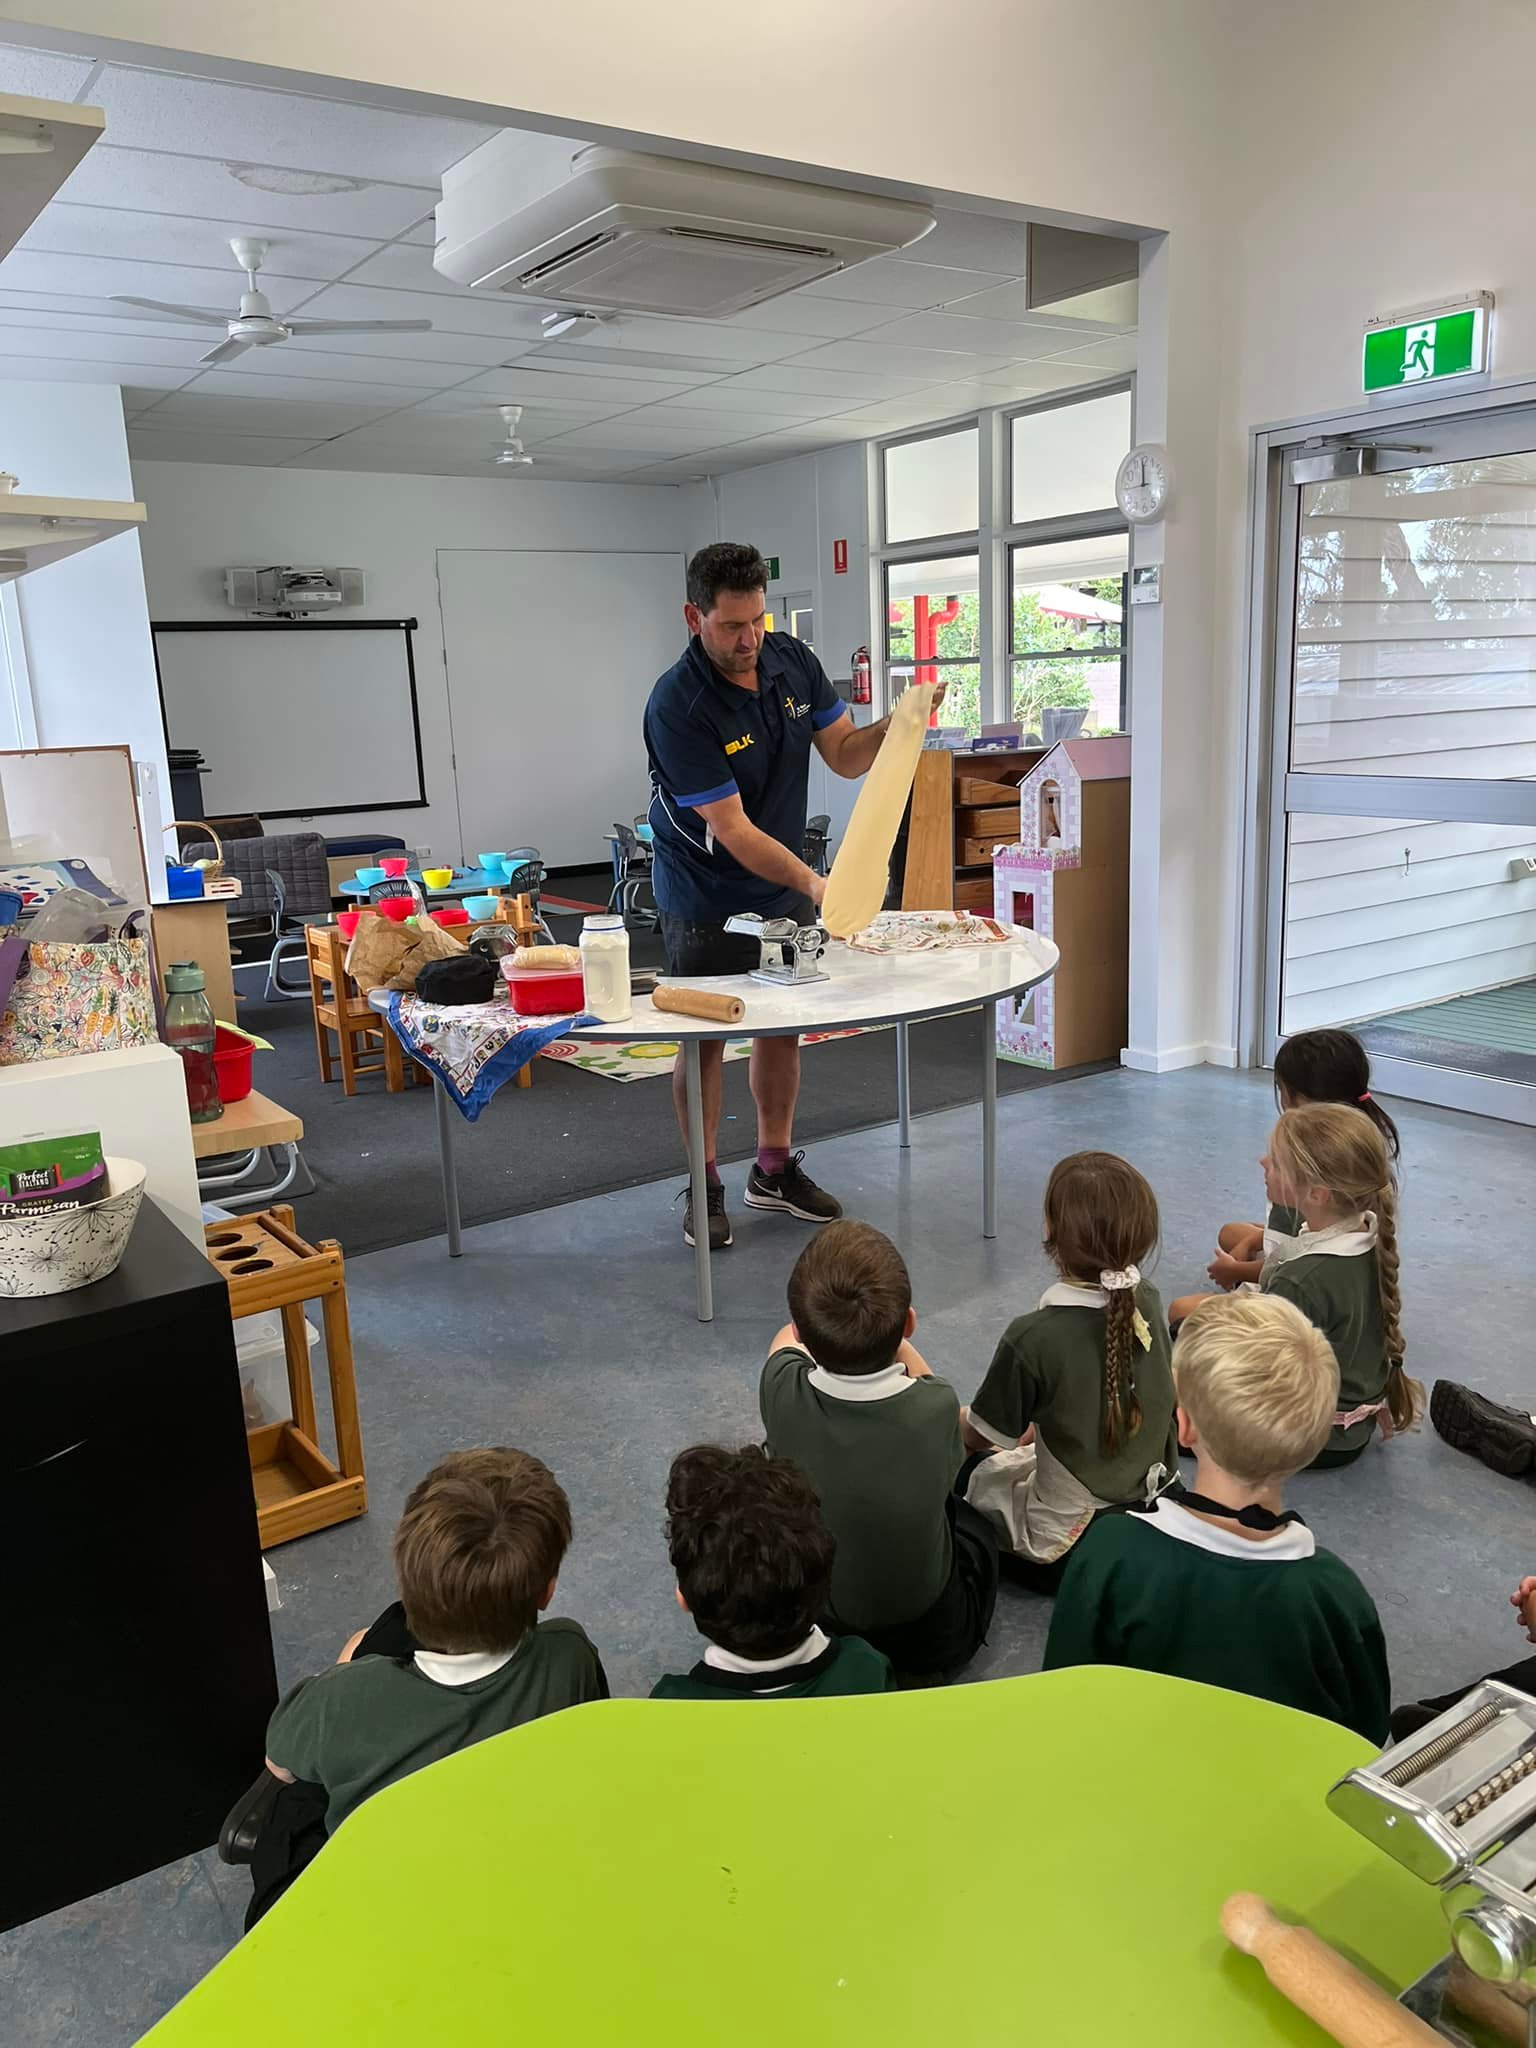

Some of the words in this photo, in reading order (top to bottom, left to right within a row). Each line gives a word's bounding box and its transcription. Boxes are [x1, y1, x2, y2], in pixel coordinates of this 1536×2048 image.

[725, 733, 755, 755] BLK
[16, 1170, 48, 1184] Perfect
[0, 1200, 80, 1216] Parmesan
[22, 1199, 54, 1208] GRATED
